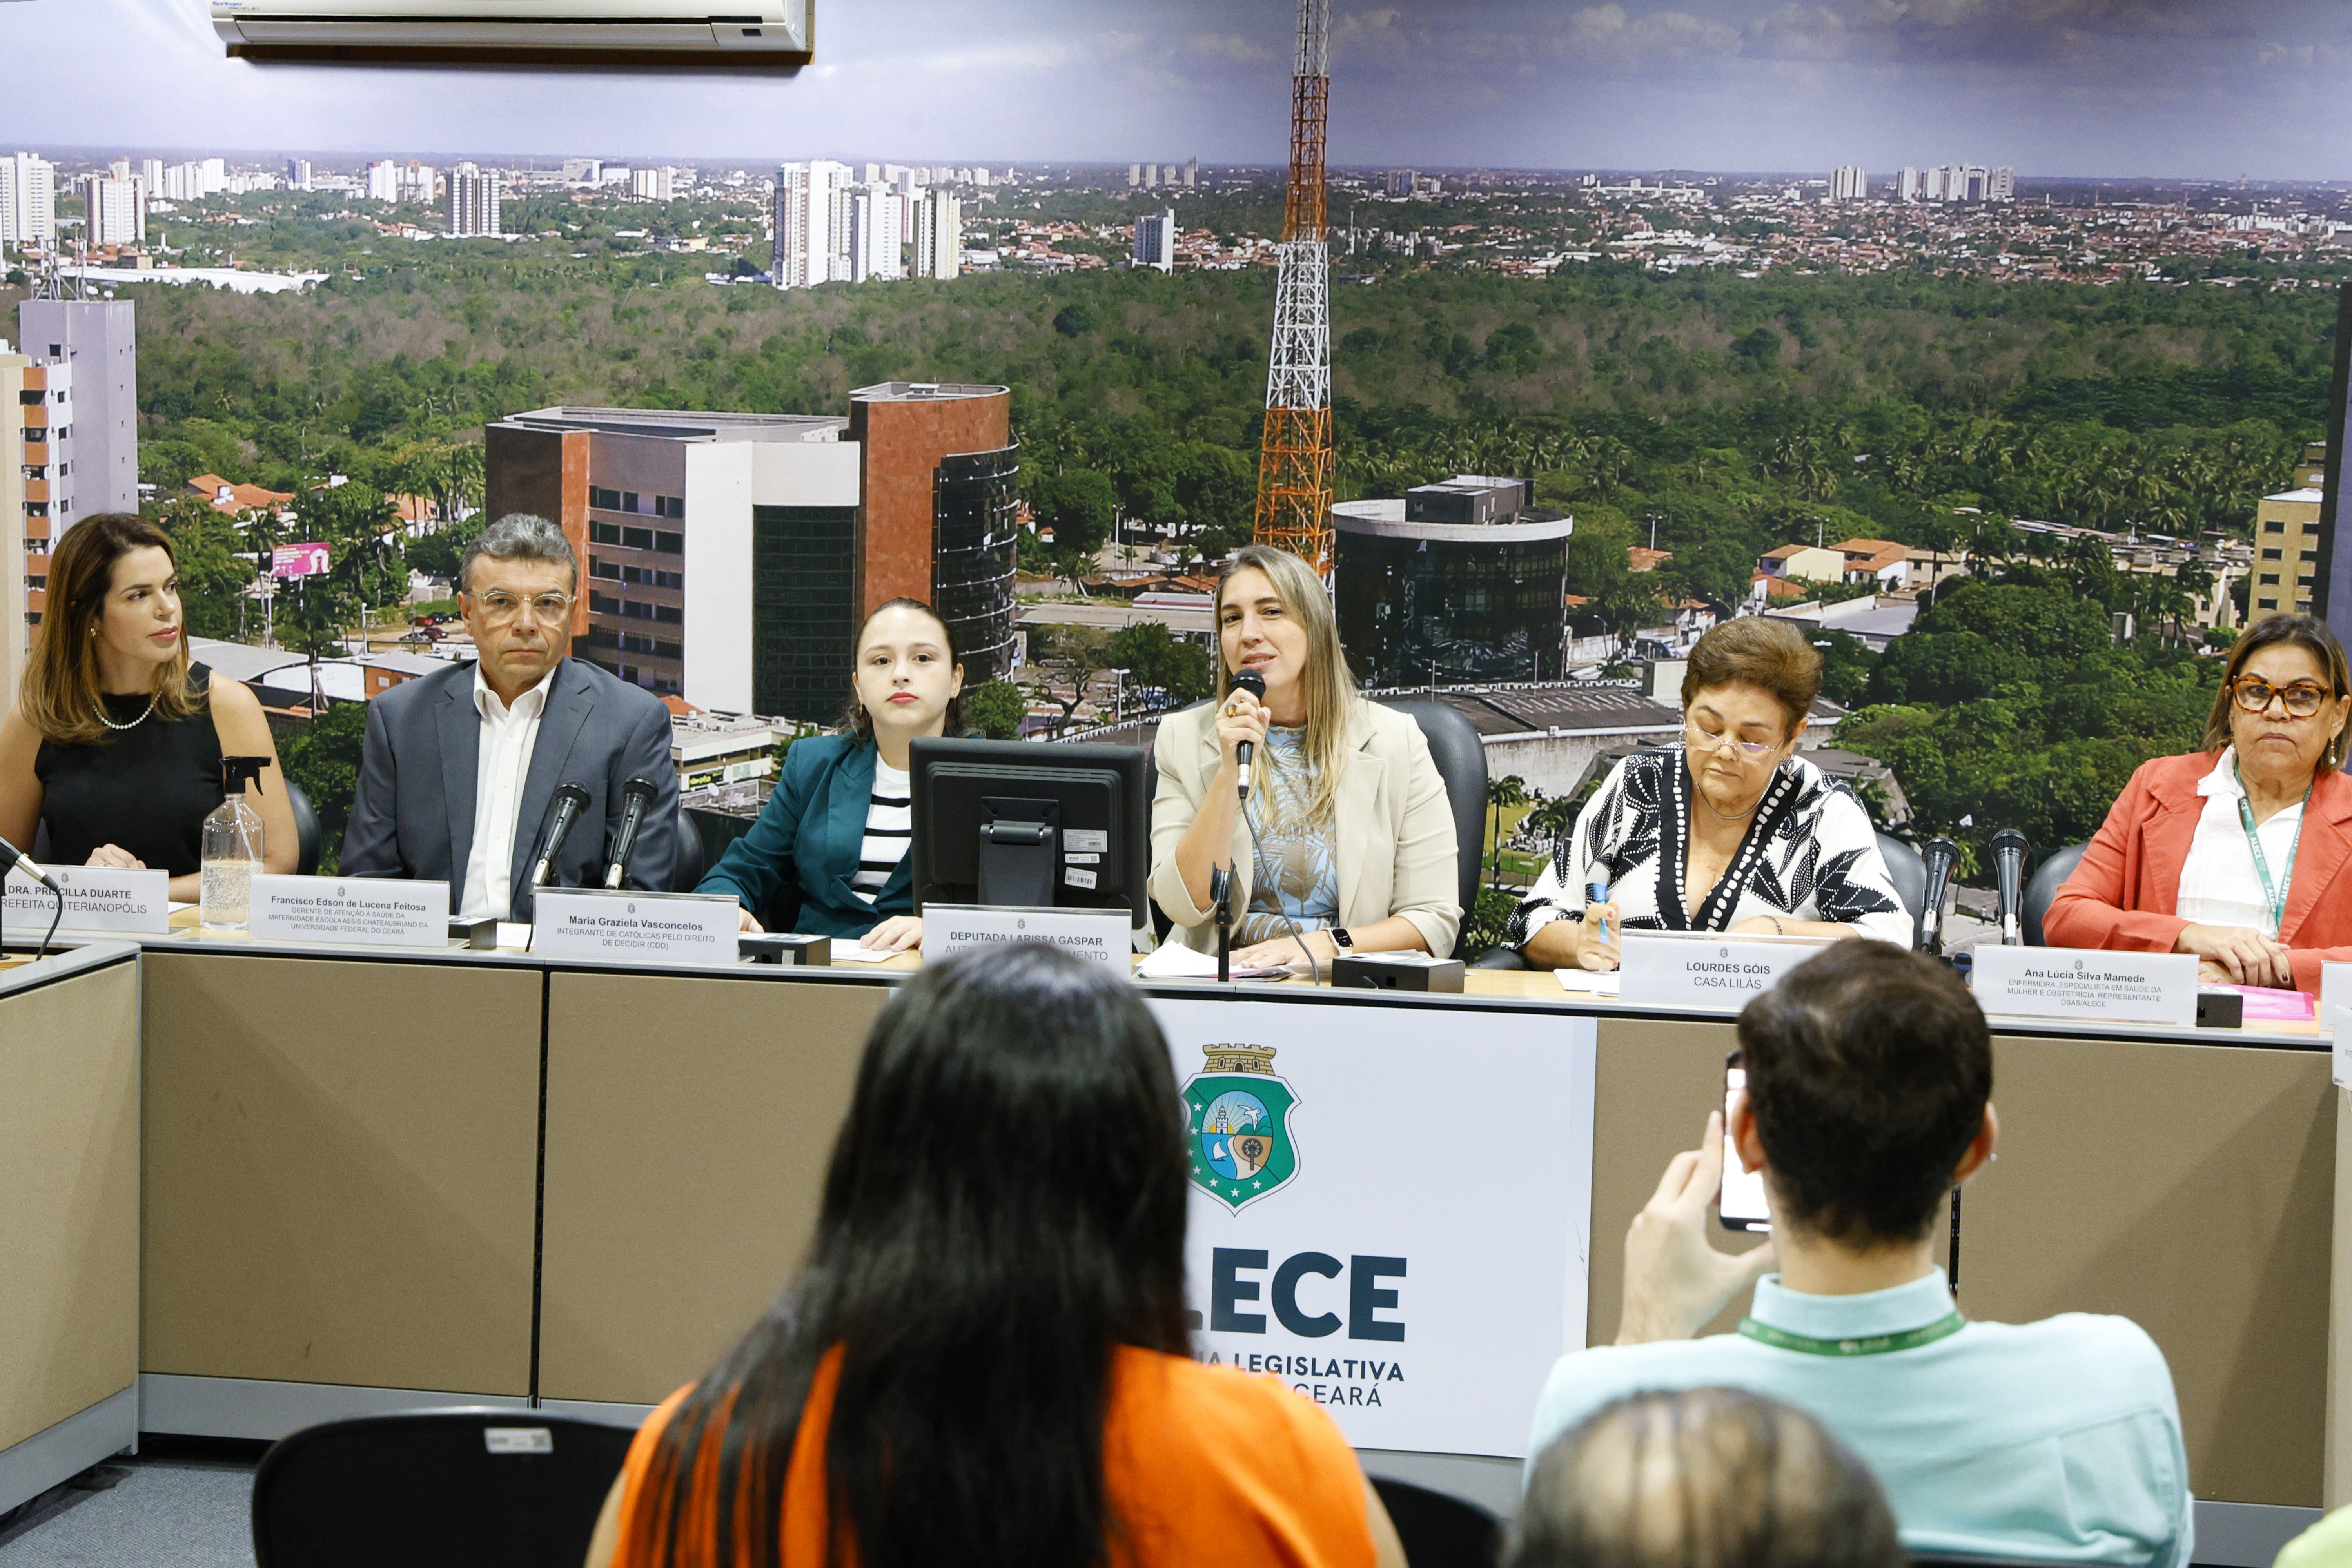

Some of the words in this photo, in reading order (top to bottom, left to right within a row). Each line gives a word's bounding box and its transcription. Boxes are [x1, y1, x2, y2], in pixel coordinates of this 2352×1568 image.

[2250, 837, 2263, 860] ALECE
[8, 886, 32, 895] DRA.
[90, 889, 131, 899] DUARTE
[2280, 875, 2291, 900] ALECE
[1, 898, 45, 909] REFEITA
[271, 896, 314, 905] Francisco
[316, 898, 343, 906] Edson
[359, 900, 391, 909] Lucena
[394, 902, 426, 911] Feitosa
[2266, 888, 2277, 913] ALECE
[291, 923, 338, 931] UNIVERSIDADE
[363, 919, 417, 927] CHATEAUBRIAND
[569, 916, 595, 925] Maria
[598, 917, 638, 927] Graziela
[641, 920, 703, 931] Vasconcelos
[557, 928, 605, 936] INTEGRANTE
[619, 931, 661, 939] CATÓLICAS
[951, 932, 1007, 942] DEPUTADA
[1058, 936, 1102, 946] GASPAR
[647, 942, 669, 950] (CDD)
[1686, 962, 1740, 973] LOURDES
[1743, 963, 1770, 974] GÓIS
[1694, 976, 1726, 987] CASA
[1729, 977, 1762, 989] LILÁS
[2025, 969, 2044, 978] Ana
[2047, 970, 2074, 979] Lúcia
[2077, 971, 2100, 980] Silva
[2104, 973, 2145, 983] Mamede
[2008, 979, 2055, 987] ENFERMEIRA
[2046, 990, 2094, 998] OBSTETRÍCIA
[2098, 992, 2161, 1002] REPRESENTANTE
[2061, 999, 2106, 1007] DSAS/ALECE
[1234, 1353, 1404, 1381] LEGISLATIVA
